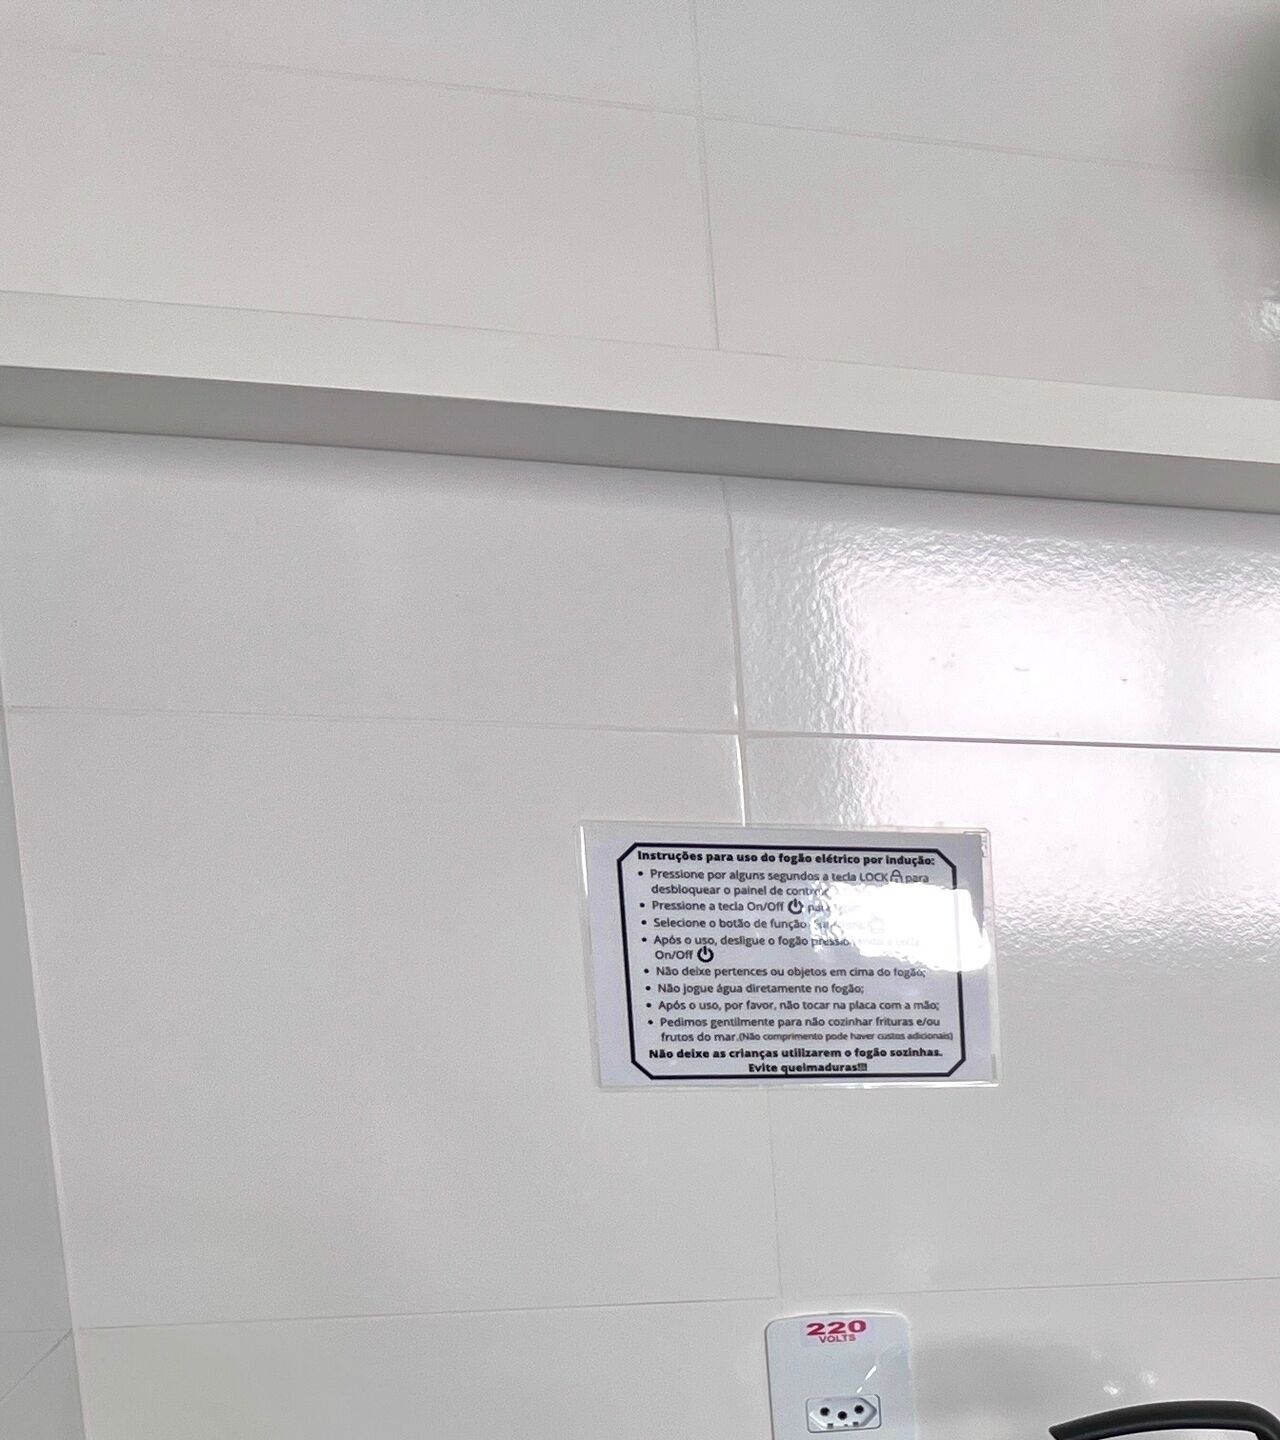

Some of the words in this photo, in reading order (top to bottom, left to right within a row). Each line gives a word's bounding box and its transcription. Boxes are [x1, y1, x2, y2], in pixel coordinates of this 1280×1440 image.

[637, 850, 703, 863] Instruções
[706, 853, 733, 863] para
[737, 853, 757, 862] uso
[761, 852, 775, 862] do
[779, 853, 811, 865] fogão
[815, 853, 860, 864] elétrico
[863, 856, 882, 867] por
[886, 855, 935, 867] indução:
[650, 869, 704, 880] Pressione
[708, 871, 725, 882] por
[729, 870, 765, 882] alguns
[768, 871, 820, 883] segundos
[832, 872, 856, 882] tecla
[860, 872, 888, 882] LOCK
[906, 875, 929, 884] para
[651, 885, 720, 897] desbloquear
[724, 887, 731, 895] o
[734, 885, 766, 897] painel
[770, 886, 783, 895] de
[652, 901, 706, 911] Pressione
[718, 901, 744, 911] tecla
[747, 901, 784, 912] On/Off
[653, 918, 706, 928] Selecione
[709, 920, 716, 928] o
[719, 918, 751, 929] botão
[754, 919, 767, 929] de
[770, 919, 807, 931] função
[653, 934, 682, 947] Após
[695, 937, 718, 947] uso,
[720, 935, 765, 948] desligue
[768, 938, 775, 946] o
[778, 936, 808, 948] fogão
[655, 950, 694, 960] On/Off
[656, 966, 679, 977] Não
[682, 967, 711, 977] deixe
[715, 967, 768, 980] pertences
[770, 969, 784, 977] ou
[787, 967, 827, 979] objetos
[830, 968, 847, 977] em
[850, 967, 875, 977] cima
[877, 967, 891, 977] do
[894, 967, 926, 979] fogão;
[658, 984, 681, 993] Não
[683, 983, 714, 995] jogue
[717, 984, 743, 995] água
[745, 984, 812, 994] diretamente
[815, 985, 829, 993] no
[831, 984, 865, 995] fogão;
[658, 1000, 687, 1012] Após
[699, 1002, 722, 1011] uso,
[725, 1002, 744, 1012] por
[746, 1000, 777, 1011] favor,
[780, 1001, 800, 1010] não
[803, 1001, 830, 1010] tocar
[833, 1002, 846, 1010] na
[850, 1000, 877, 1012] placa
[879, 1002, 902, 1010] com
[904, 1002, 911, 1010] a
[914, 1001, 940, 1011] mão;
[660, 1017, 708, 1027] Pedimos
[710, 1017, 775, 1029] gentilmente
[778, 1019, 802, 1028] para
[805, 1017, 826, 1026] não
[828, 1017, 873, 1027] cozinhar
[876, 1016, 914, 1027] frituras
[916, 1017, 940, 1027] e/ou
[661, 1032, 695, 1042] frutos
[697, 1032, 711, 1042] do
[762, 1033, 824, 1043] comprimento
[825, 1032, 848, 1042] pode
[850, 1031, 875, 1041] haver
[877, 1031, 906, 1041] custos
[907, 1031, 954, 1041] adicionais)
[649, 1049, 674, 1059] Não
[677, 1049, 710, 1059] deixe
[713, 1051, 727, 1059] as
[729, 1049, 779, 1060] crianças
[781, 1049, 842, 1058] utilizarem
[844, 1050, 851, 1058] o
[854, 1048, 888, 1060] fogão
[890, 1048, 943, 1057] sozinhas.
[748, 1063, 778, 1073] Evite
[806, 1319, 867, 1336] 220
[819, 1334, 857, 1344] VOLTS
